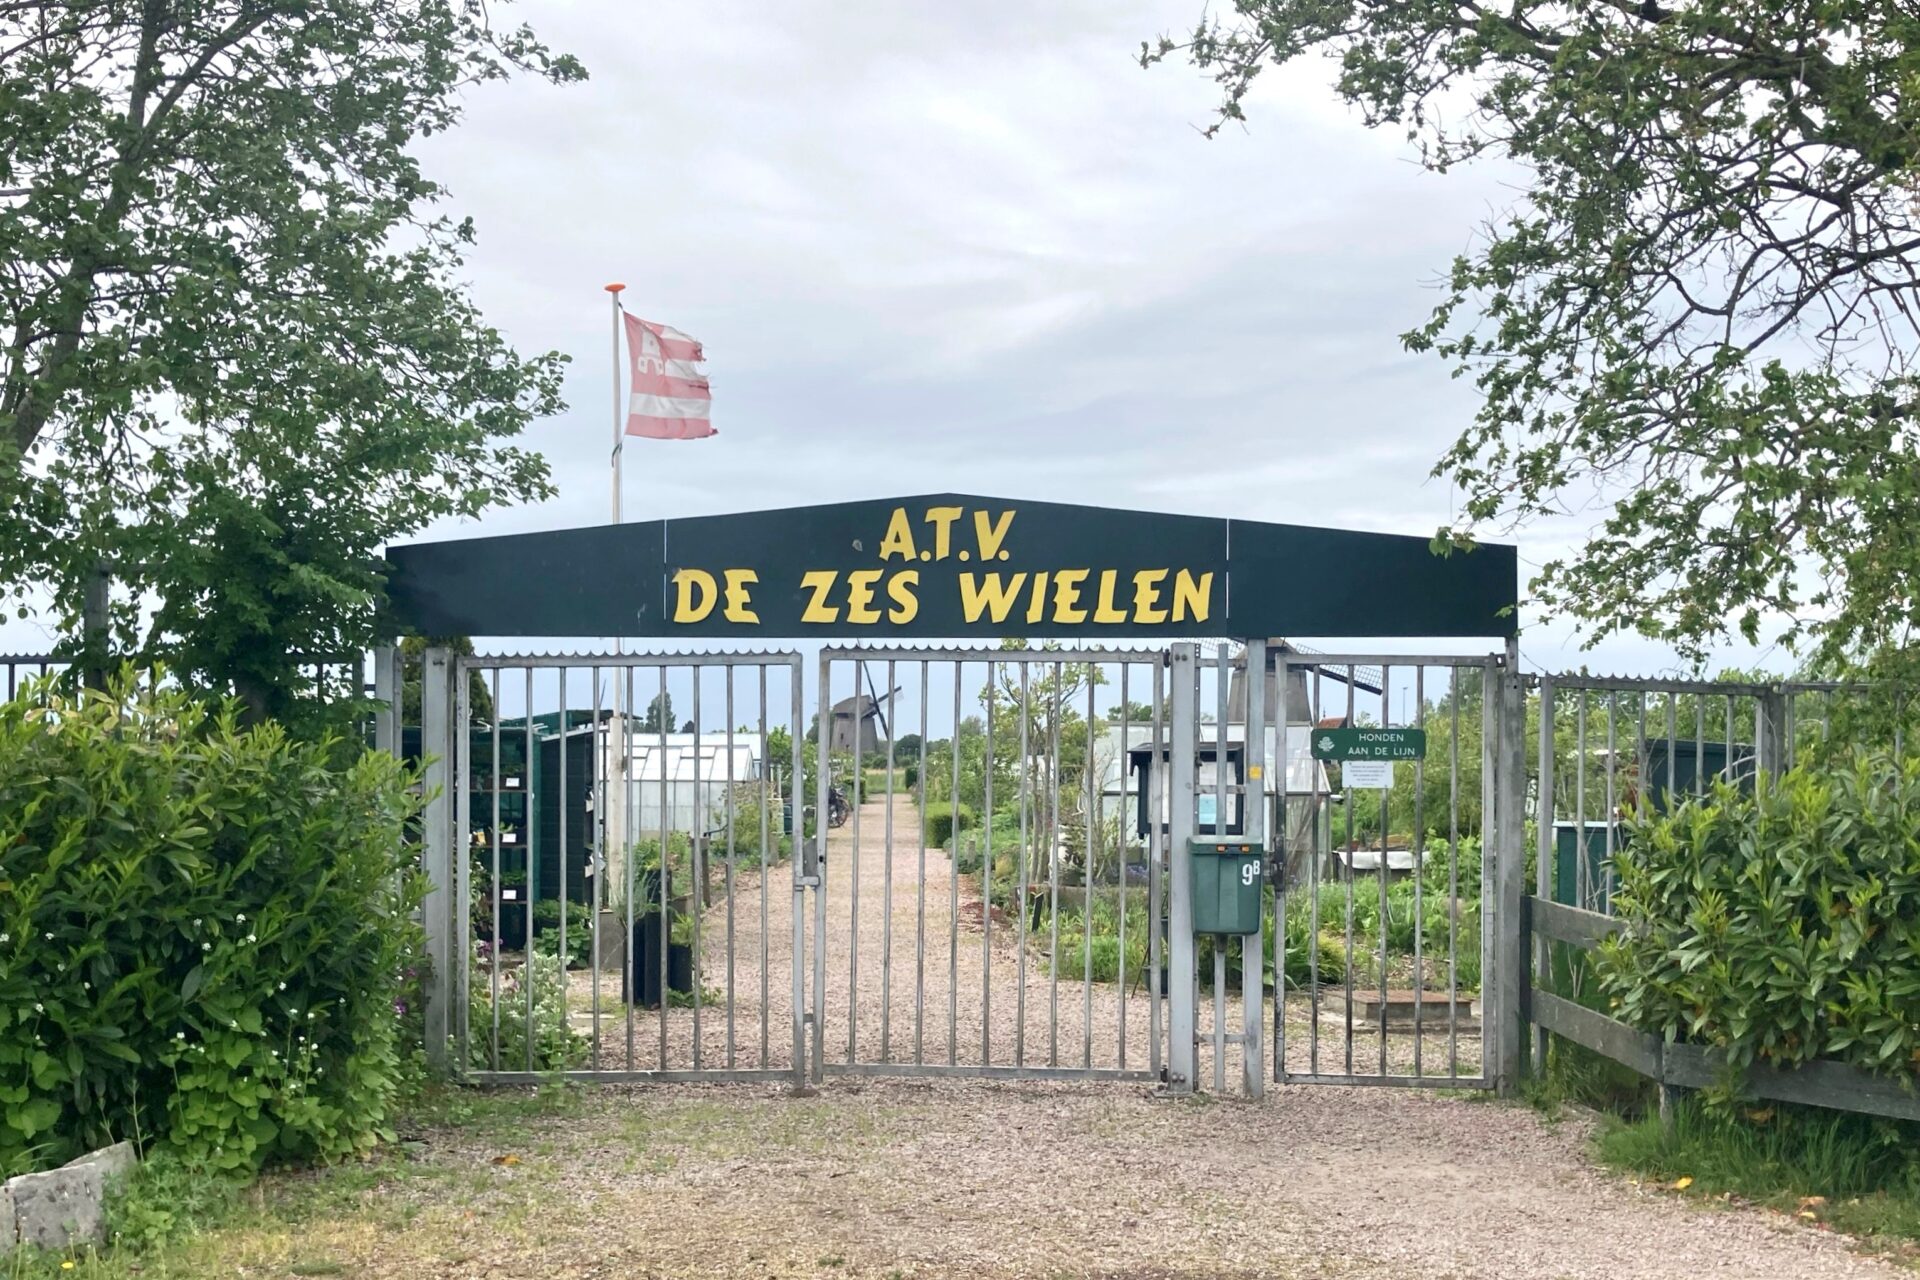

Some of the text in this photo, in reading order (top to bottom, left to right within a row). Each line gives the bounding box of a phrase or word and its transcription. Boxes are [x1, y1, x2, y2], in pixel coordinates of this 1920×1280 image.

[879, 507, 1017, 560] A.T.V.
[673, 567, 1214, 623] DE ZES WIELEN
[1348, 747, 1415, 756] AAN DE LIJN
[1358, 733, 1404, 742] HONDEN
